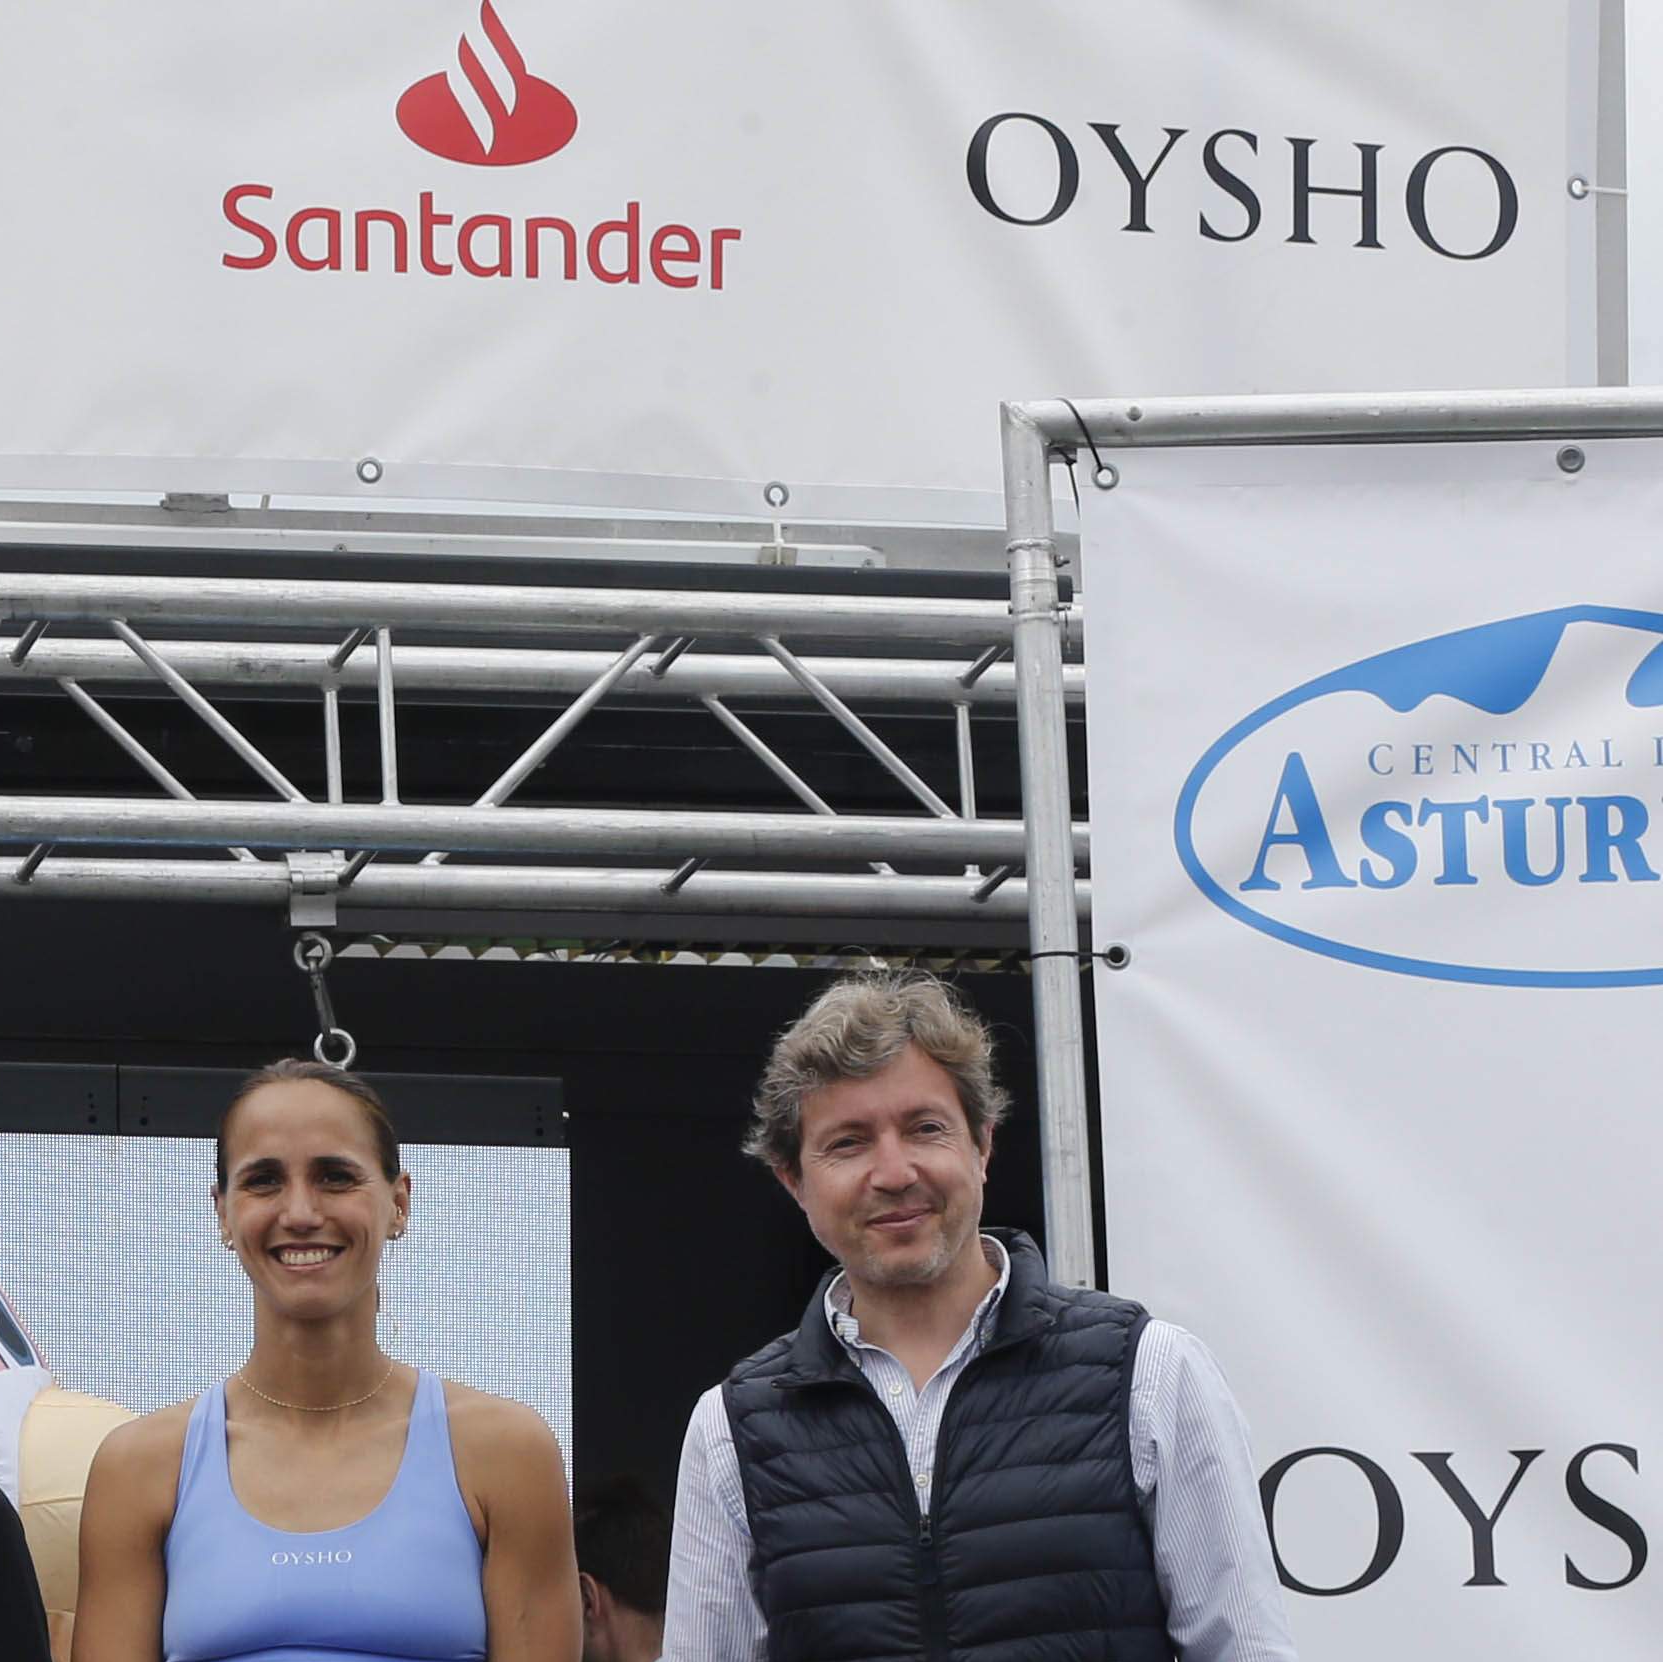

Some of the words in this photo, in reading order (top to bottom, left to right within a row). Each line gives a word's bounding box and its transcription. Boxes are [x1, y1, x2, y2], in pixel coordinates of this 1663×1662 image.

[965, 111, 1520, 261] OYSHO
[219, 182, 742, 291] Santander
[1368, 738, 1623, 775] CENTRAL
[272, 1549, 353, 1565] OYSHO
